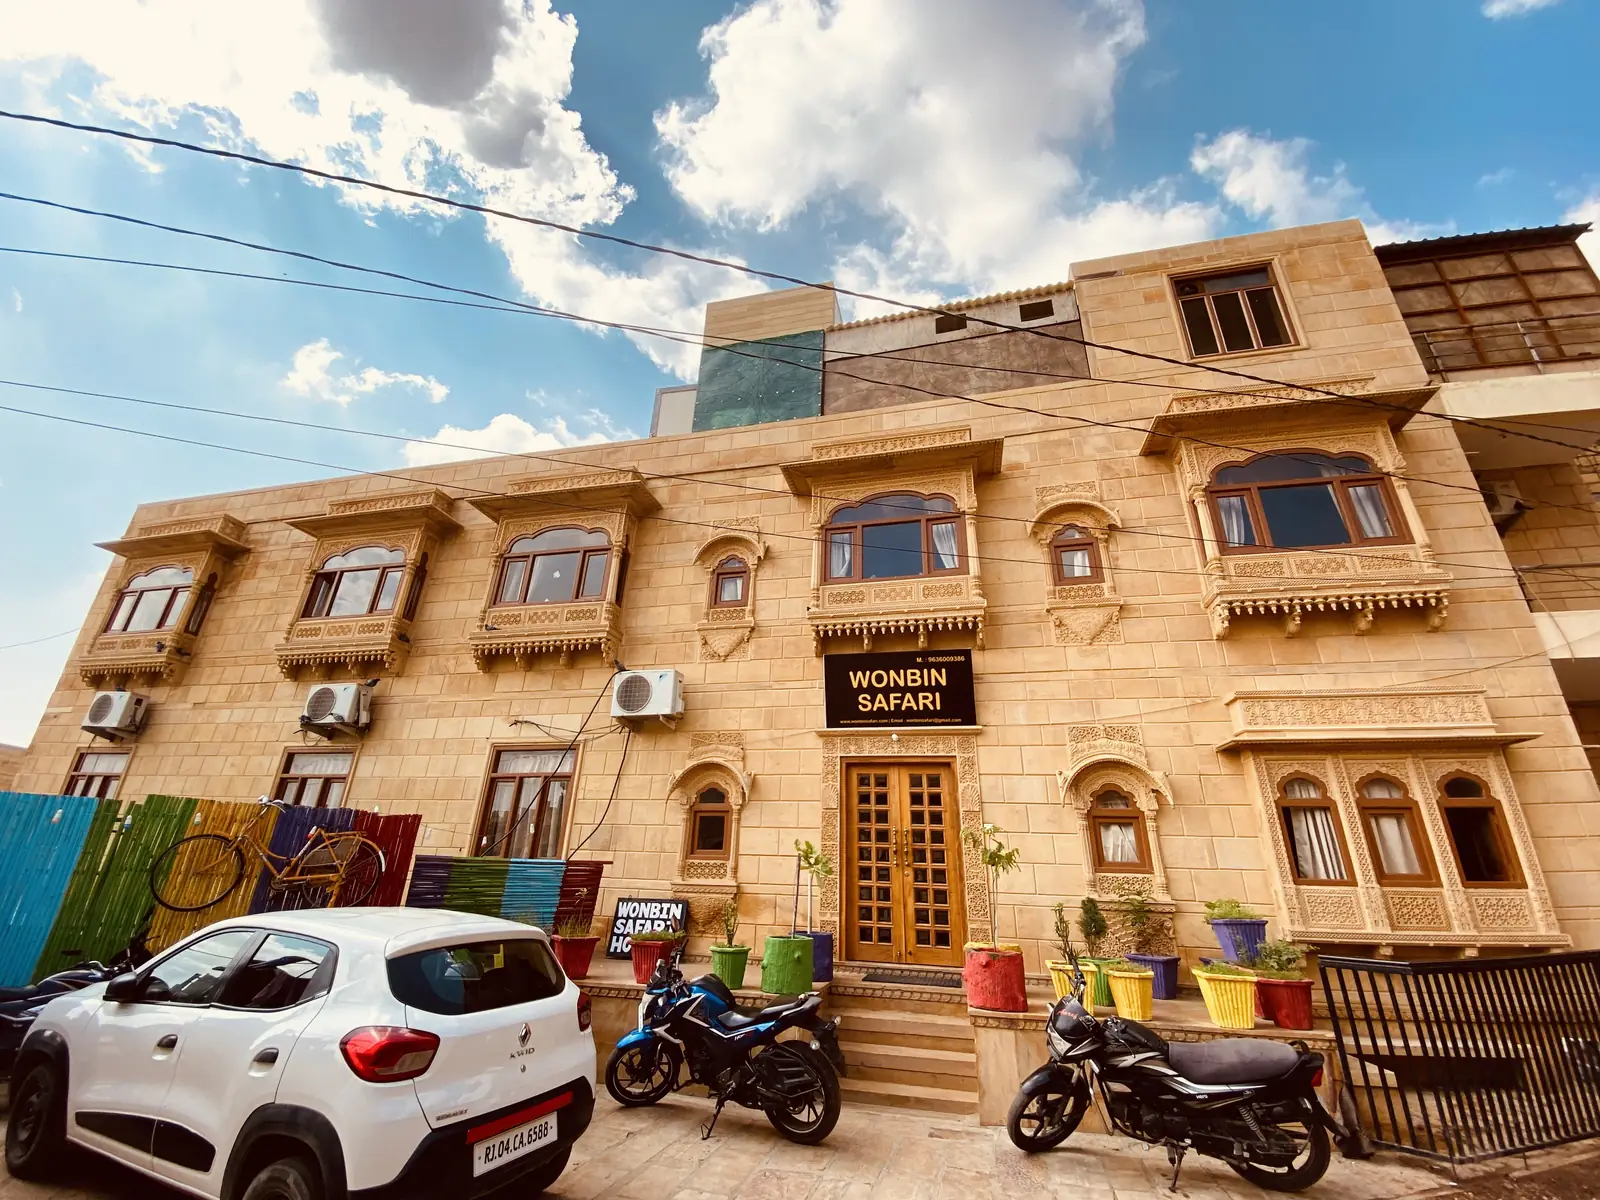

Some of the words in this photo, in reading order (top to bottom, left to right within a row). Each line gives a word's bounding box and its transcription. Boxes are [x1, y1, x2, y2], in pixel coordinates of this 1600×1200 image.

[849, 668, 947, 688] WONBIN
[858, 692, 941, 712] SAFARI
[618, 902, 683, 919] WONBIN
[509, 1047, 536, 1060] KWID
[484, 1121, 549, 1164] RJ.04.CA.6588
